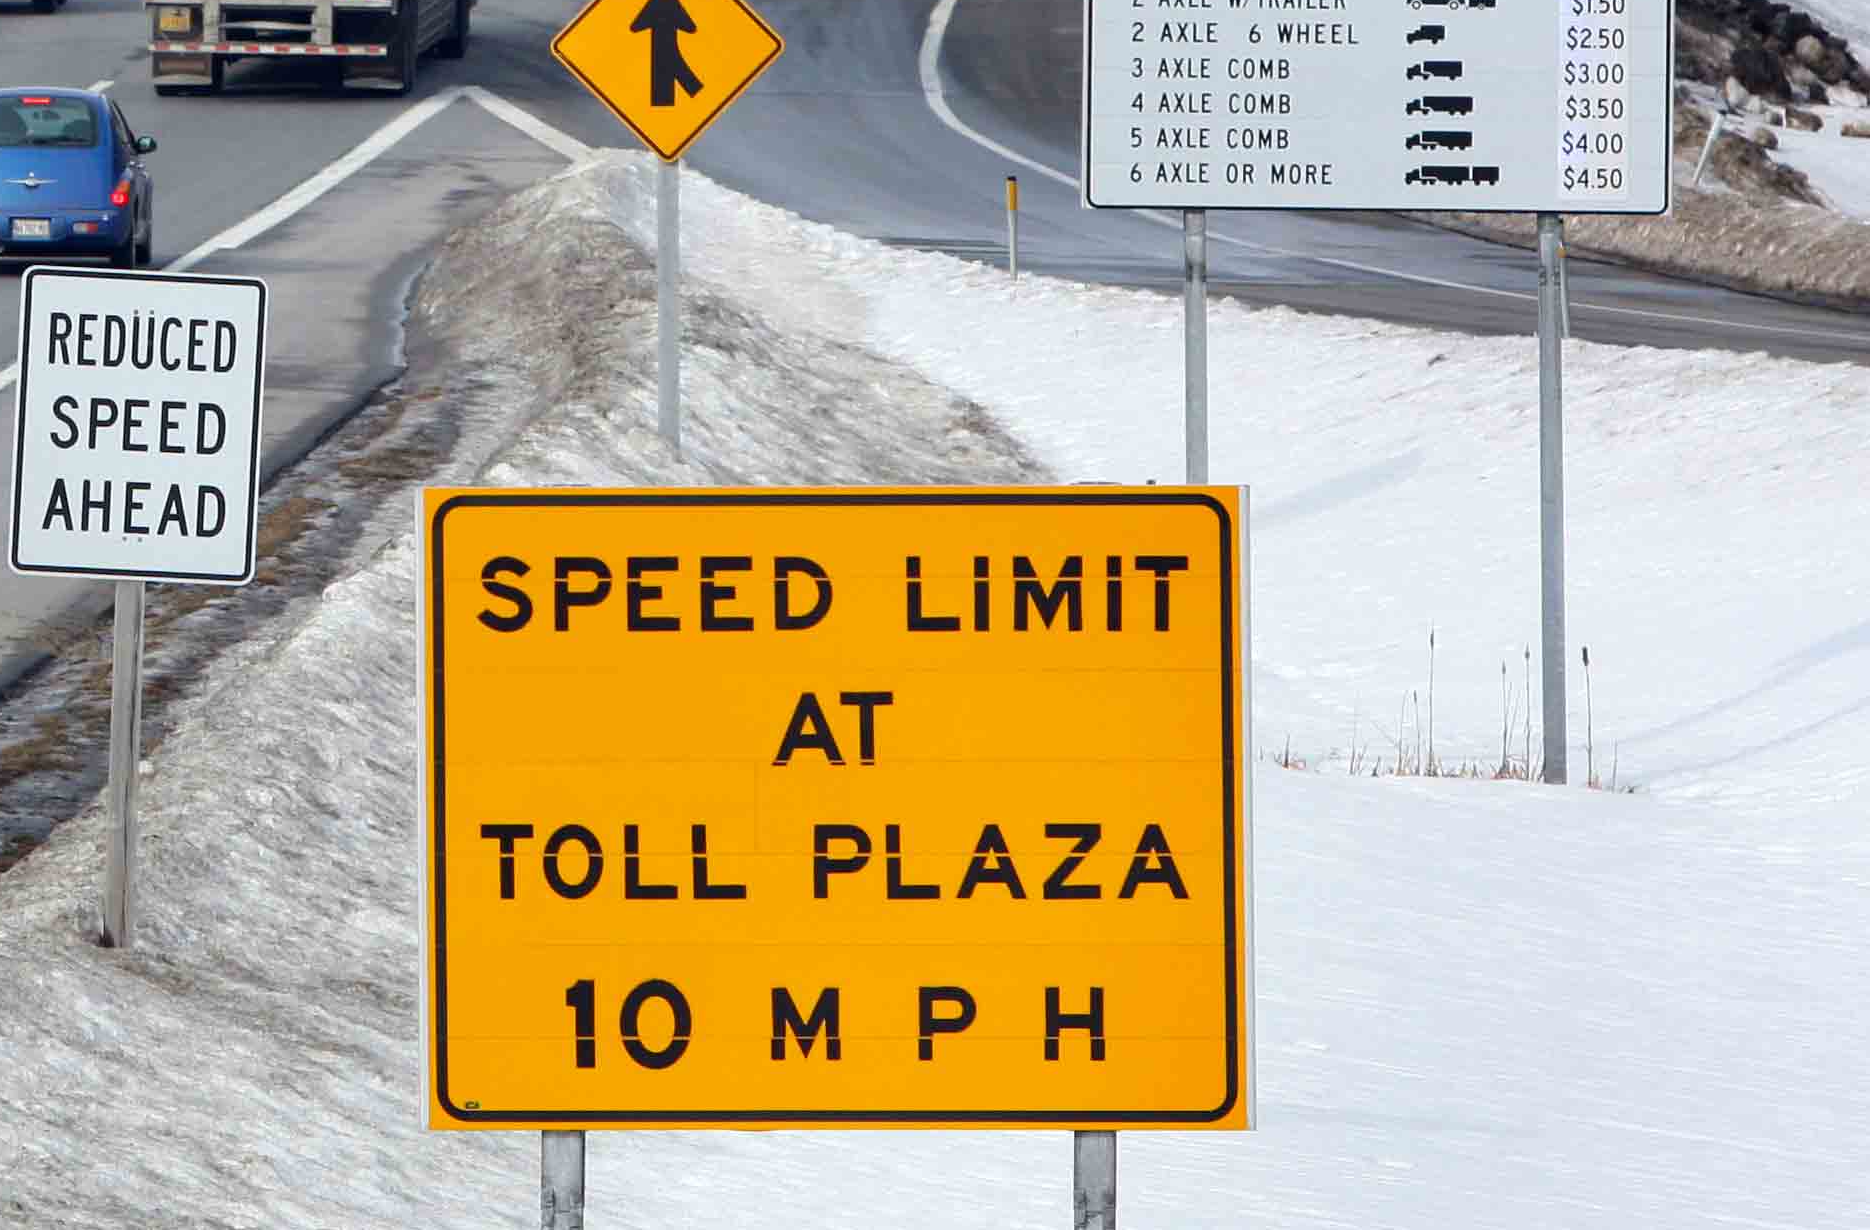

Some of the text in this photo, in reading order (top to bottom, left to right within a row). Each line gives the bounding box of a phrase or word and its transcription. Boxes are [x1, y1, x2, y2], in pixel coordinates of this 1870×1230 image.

[1132, 23, 1359, 45] 2 AXLE 6 WHEEL
[1566, 28, 1624, 51] $2.50
[1132, 58, 1290, 79] 3 AXLE COMB
[1564, 62, 1624, 85] $3.00
[1132, 93, 1291, 114] 4 AXLE COMB
[1565, 97, 1623, 120] $3.50
[1131, 128, 1289, 149] 5 AXLE COMB
[1562, 132, 1623, 155] $4.00
[1130, 162, 1332, 185] 6 AXLE OR MORE
[1563, 167, 1623, 190] $4.50
[49, 311, 237, 372] REDUCED
[50, 396, 226, 455] SPEED
[41, 478, 226, 538] AHEAD
[477, 556, 1188, 632] SPEED LIMIT
[772, 691, 893, 765] AT
[481, 824, 1189, 900] TOLL PLAZA
[566, 978, 691, 1070] 10
